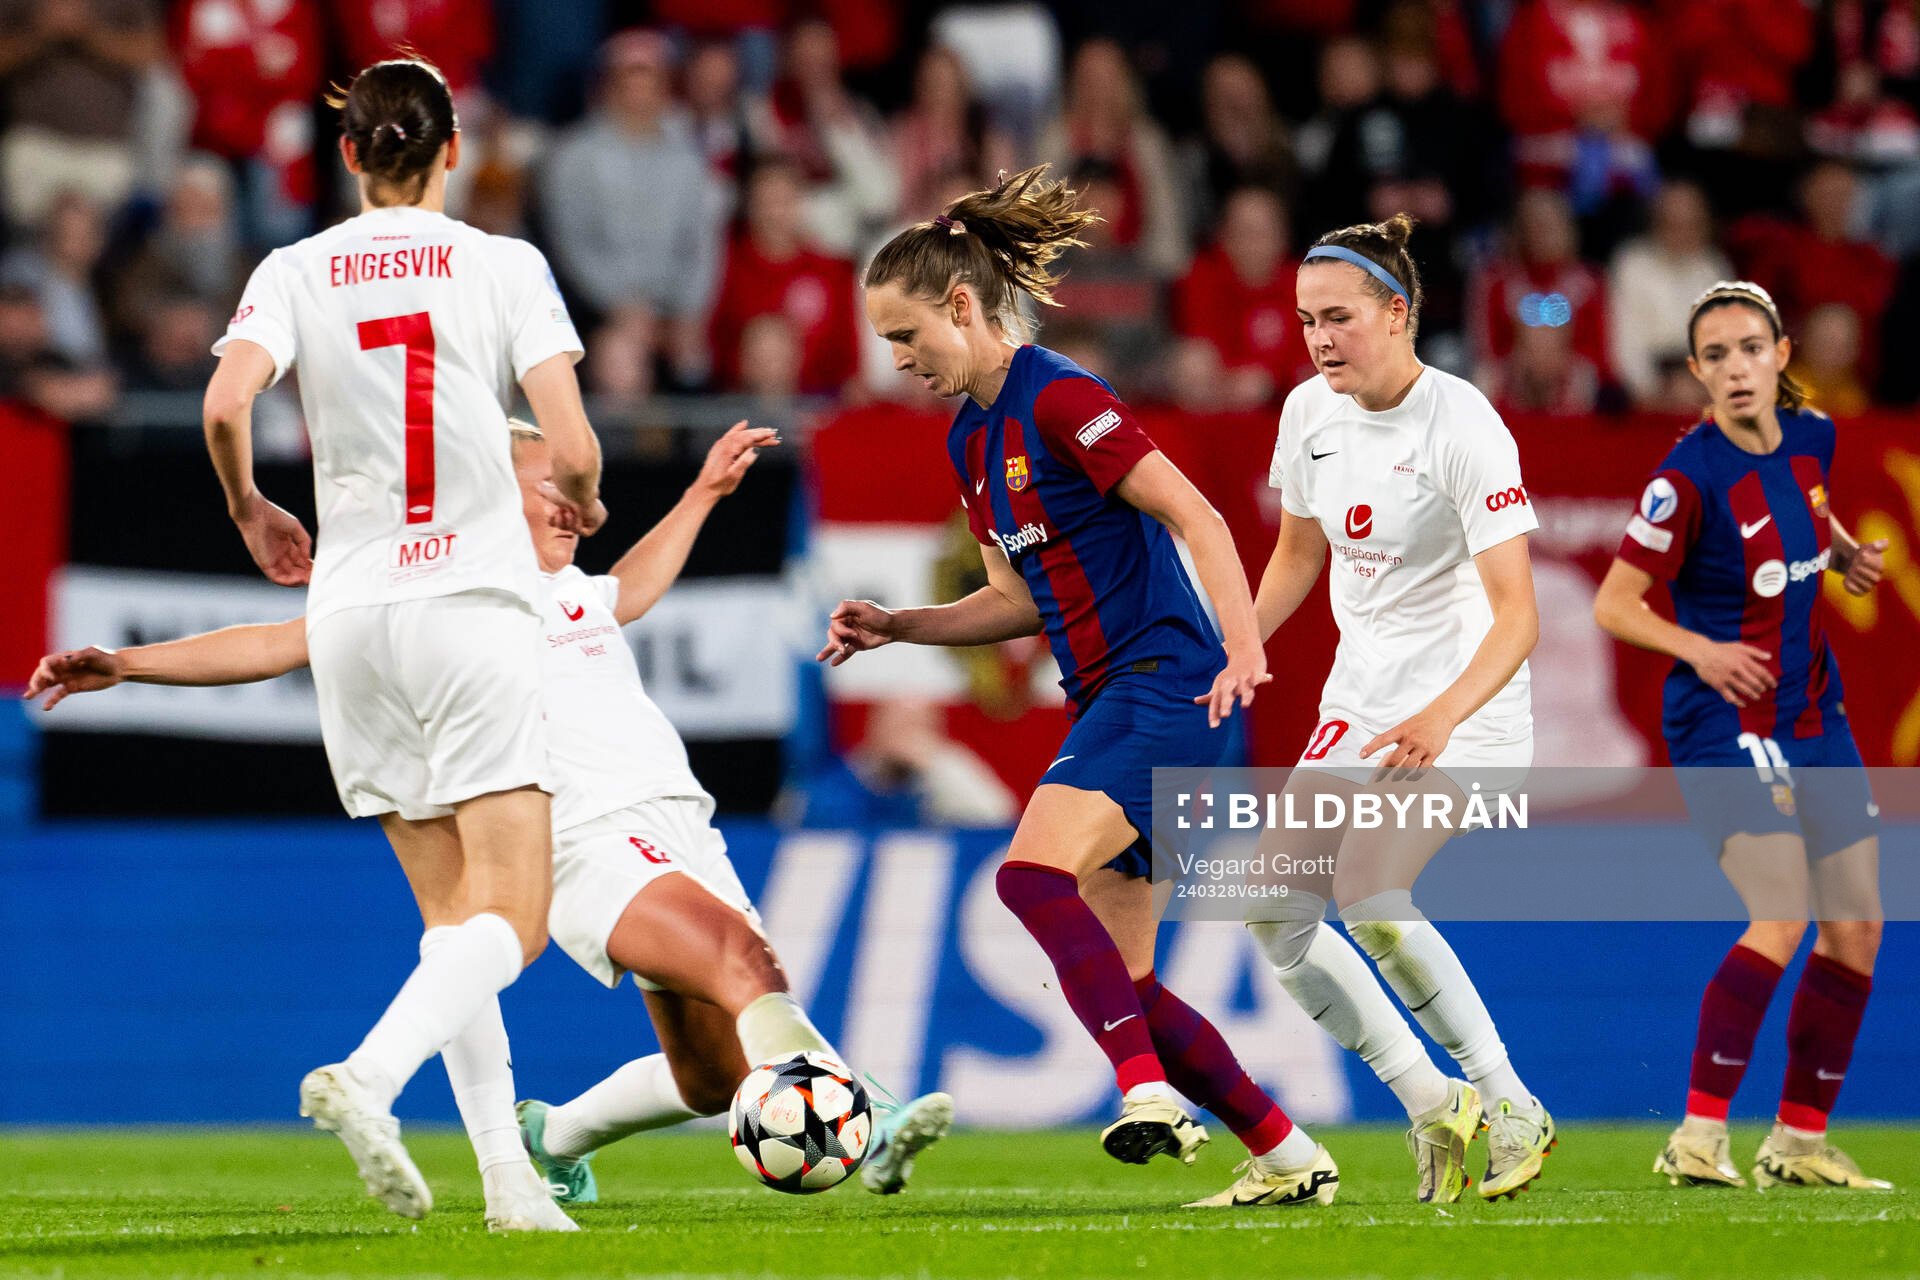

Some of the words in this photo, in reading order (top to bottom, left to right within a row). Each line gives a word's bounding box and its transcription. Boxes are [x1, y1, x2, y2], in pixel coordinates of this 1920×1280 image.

[331, 245, 453, 287] ENGESVIK
[356, 311, 435, 525] 7
[1078, 411, 1122, 447] BIMBO
[399, 534, 457, 567] MOT
[1003, 522, 1048, 553] Spotify
[1353, 560, 1377, 579] Vest
